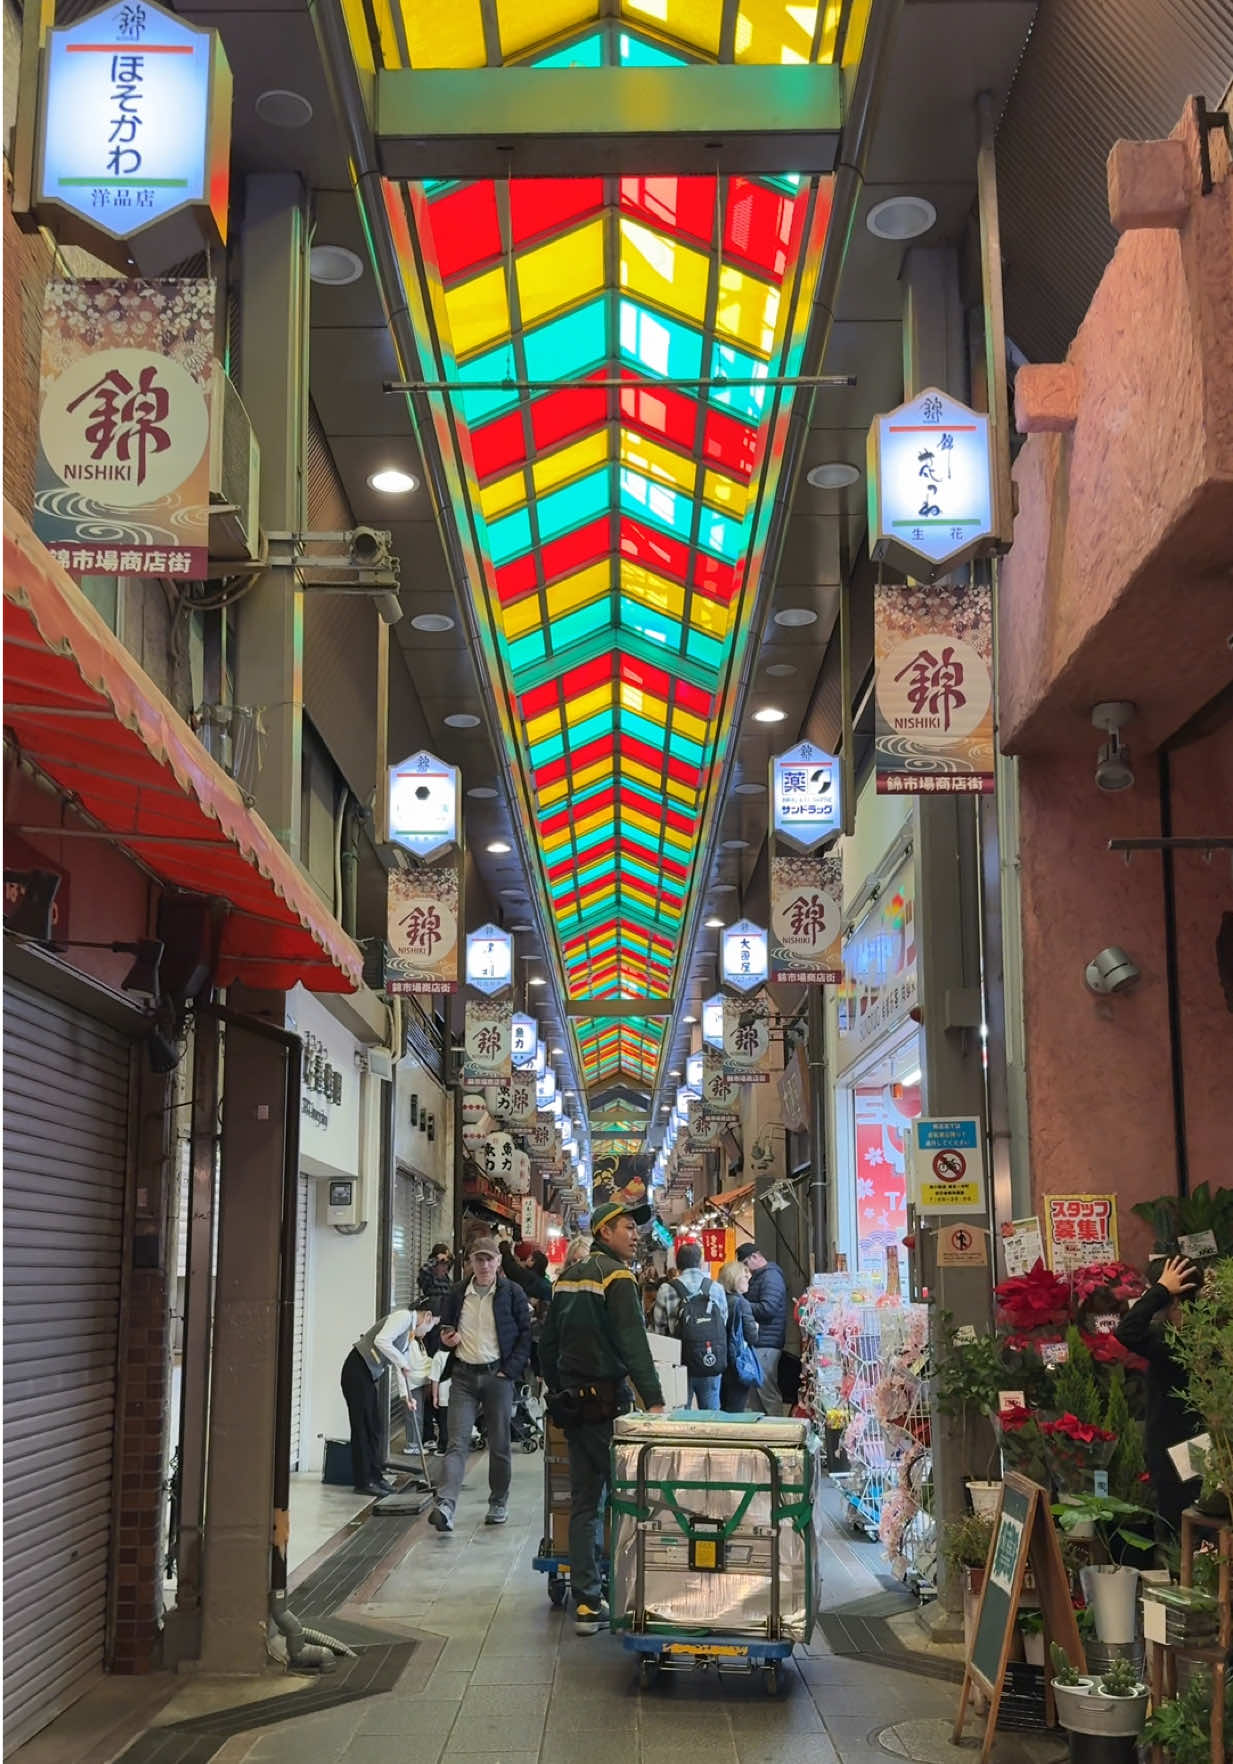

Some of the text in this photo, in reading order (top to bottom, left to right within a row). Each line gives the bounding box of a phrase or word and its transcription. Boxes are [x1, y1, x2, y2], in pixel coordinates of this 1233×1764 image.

[107, 55, 144, 175] ほそかわ
[91, 188, 154, 208] 洋品店
[66, 366, 172, 487] 錦
[64, 464, 131, 481] NISHIKI
[894, 647, 967, 732] 錦
[894, 717, 940, 729] NISHIKI
[784, 771, 806, 793] 薬
[887, 776, 983, 791] 錦市場商店街
[782, 804, 833, 815] サンドラッグ
[399, 905, 442, 957] 錦
[782, 894, 826, 946] 錦
[392, 982, 451, 993] 錦市場商店街
[777, 972, 836, 982] 錦市場商店街
[472, 1025, 502, 1061] 錦
[729, 1024, 759, 1057] 錦
[1052, 1201, 1109, 1218] スタッフ
[1054, 1218, 1106, 1241] 募集!
